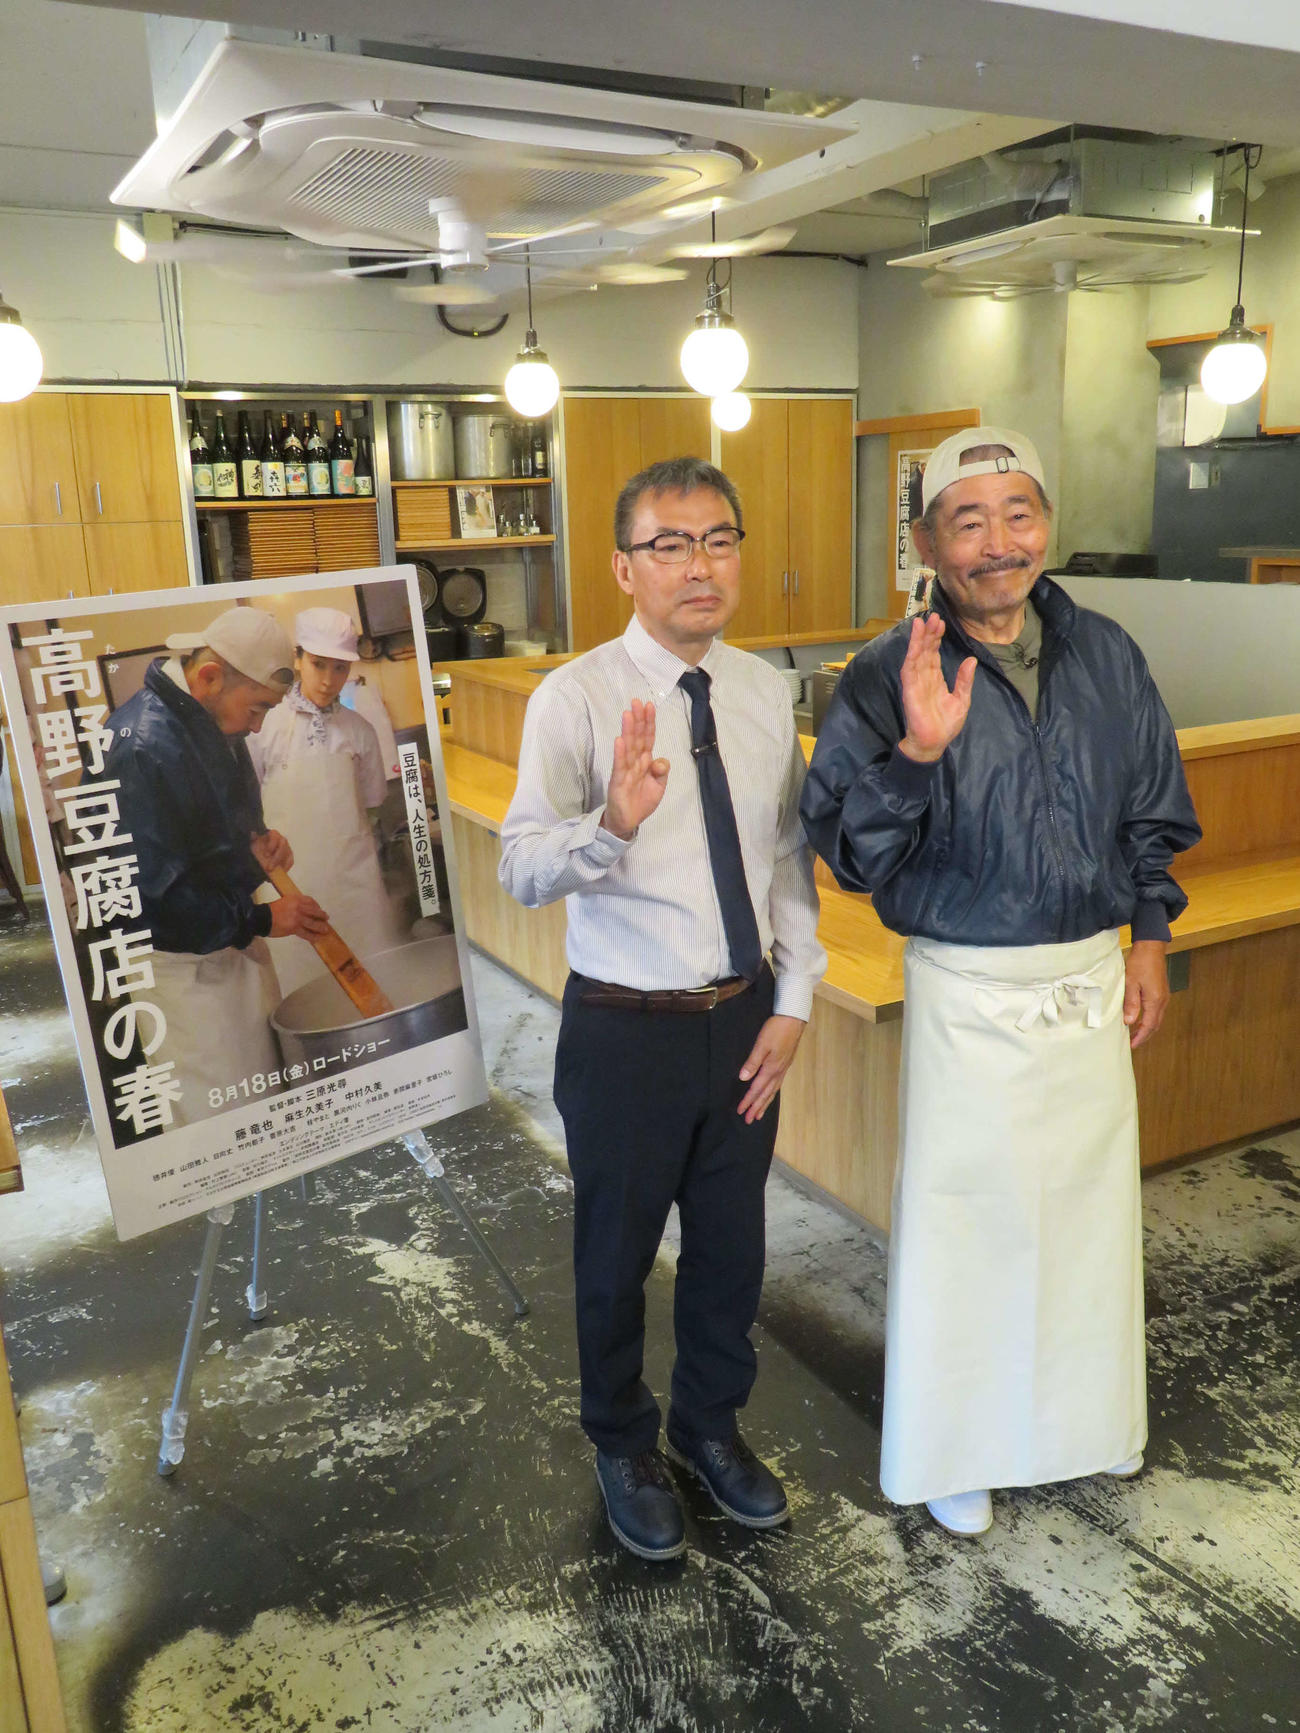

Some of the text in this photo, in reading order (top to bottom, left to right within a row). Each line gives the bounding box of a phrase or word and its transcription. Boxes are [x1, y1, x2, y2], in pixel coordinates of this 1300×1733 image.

[120, 727, 131, 738] の
[403, 752, 438, 905] 豆腐は、人生の処方箋。
[21, 628, 183, 1134] 高野豆腐店の春
[313, 1038, 391, 1071] ロードショー
[284, 1098, 334, 1123] 麻生久美子
[345, 1081, 382, 1101] 中村久美
